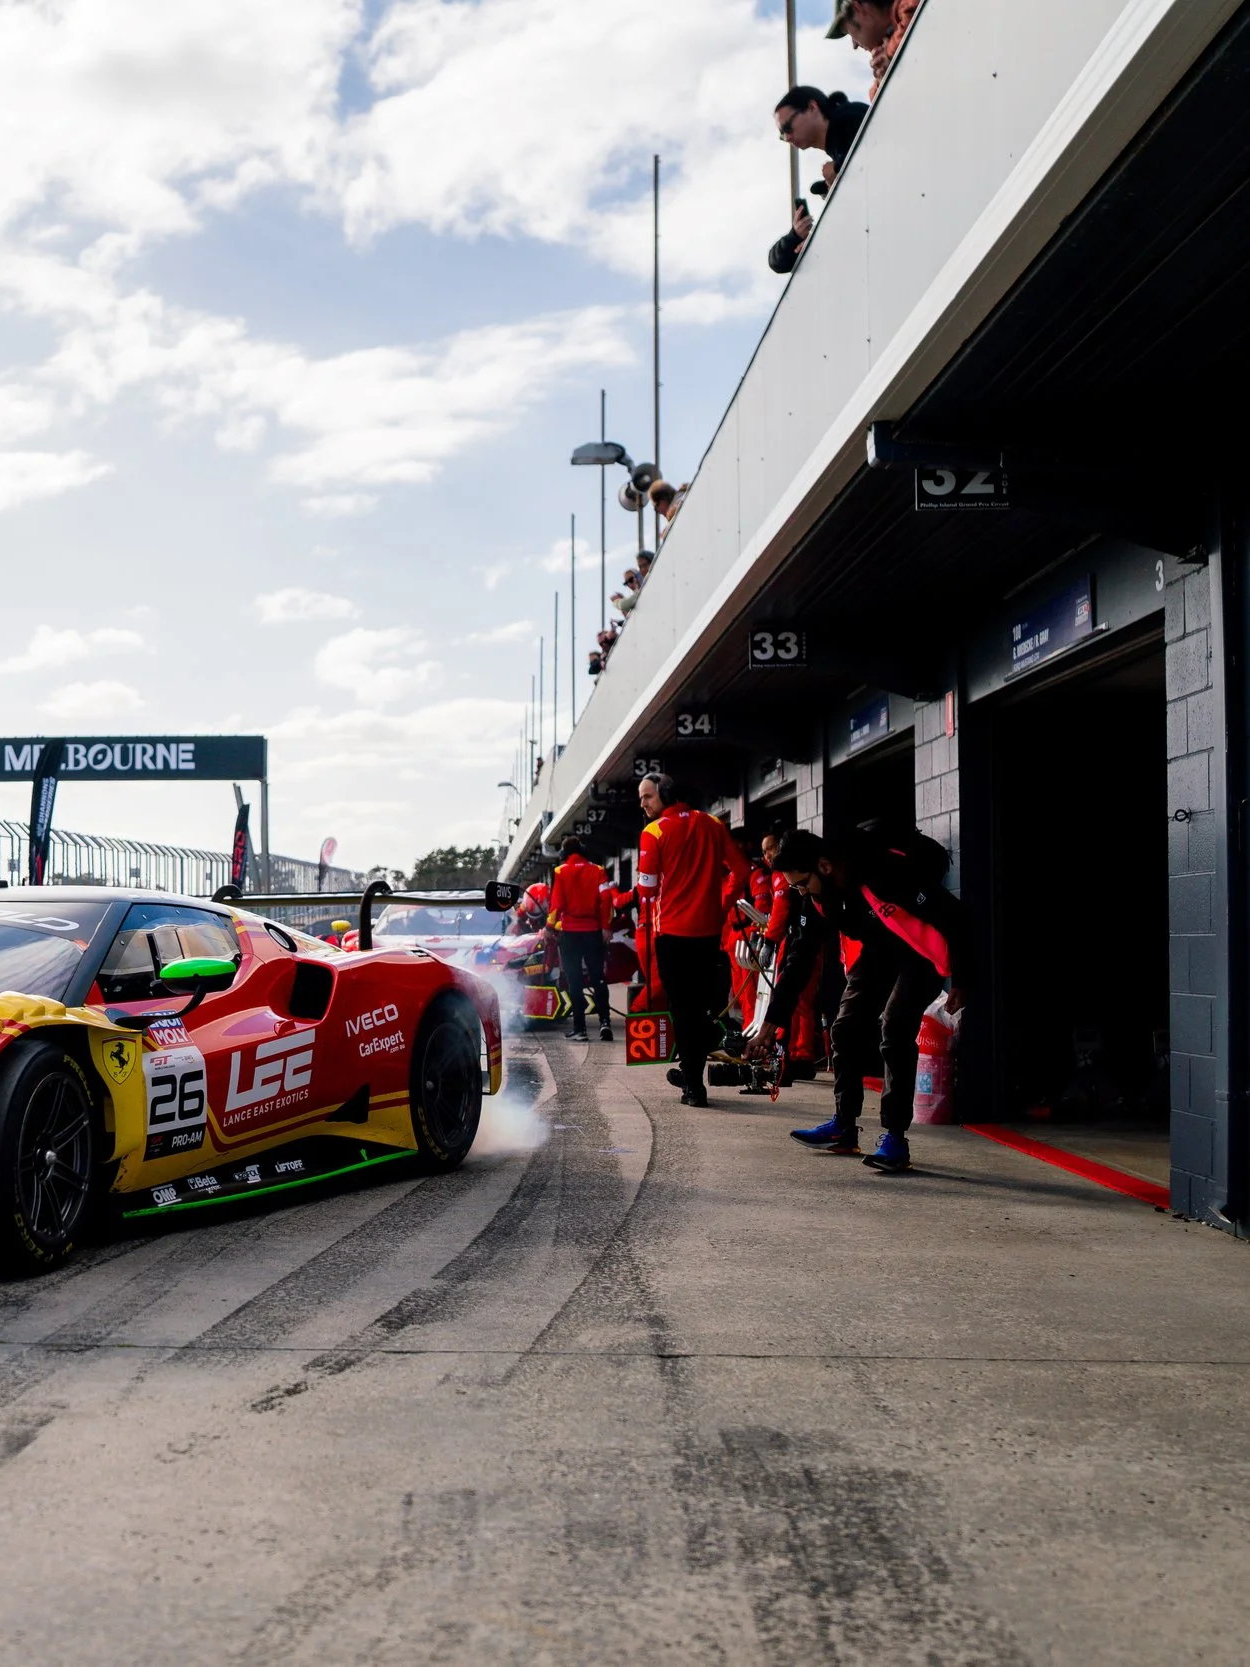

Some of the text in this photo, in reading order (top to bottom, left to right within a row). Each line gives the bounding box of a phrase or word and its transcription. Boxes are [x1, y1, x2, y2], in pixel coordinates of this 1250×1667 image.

[921, 469, 995, 495] 32
[753, 631, 799, 660] 33
[677, 714, 712, 735] 34
[4, 742, 196, 771] MBOURNE
[634, 759, 661, 776] 35
[588, 810, 607, 822] 37
[575, 824, 592, 835] 38
[496, 885, 512, 899] aws
[345, 1003, 399, 1038] IVECO
[152, 1028, 190, 1046] MOLY
[359, 1029, 405, 1058] CarExpert
[629, 1019, 657, 1059] 26
[659, 1018, 667, 1058] ENGINE OFF
[224, 1028, 316, 1112] LEE
[149, 1069, 205, 1126] 26
[223, 1088, 309, 1128] LANCE EAST EXOTICS
[171, 1130, 203, 1148] PRO-AM
[275, 1159, 303, 1173] LIFTOFF
[195, 1174, 218, 1188] Beta
[153, 1187, 177, 1204] OMP
